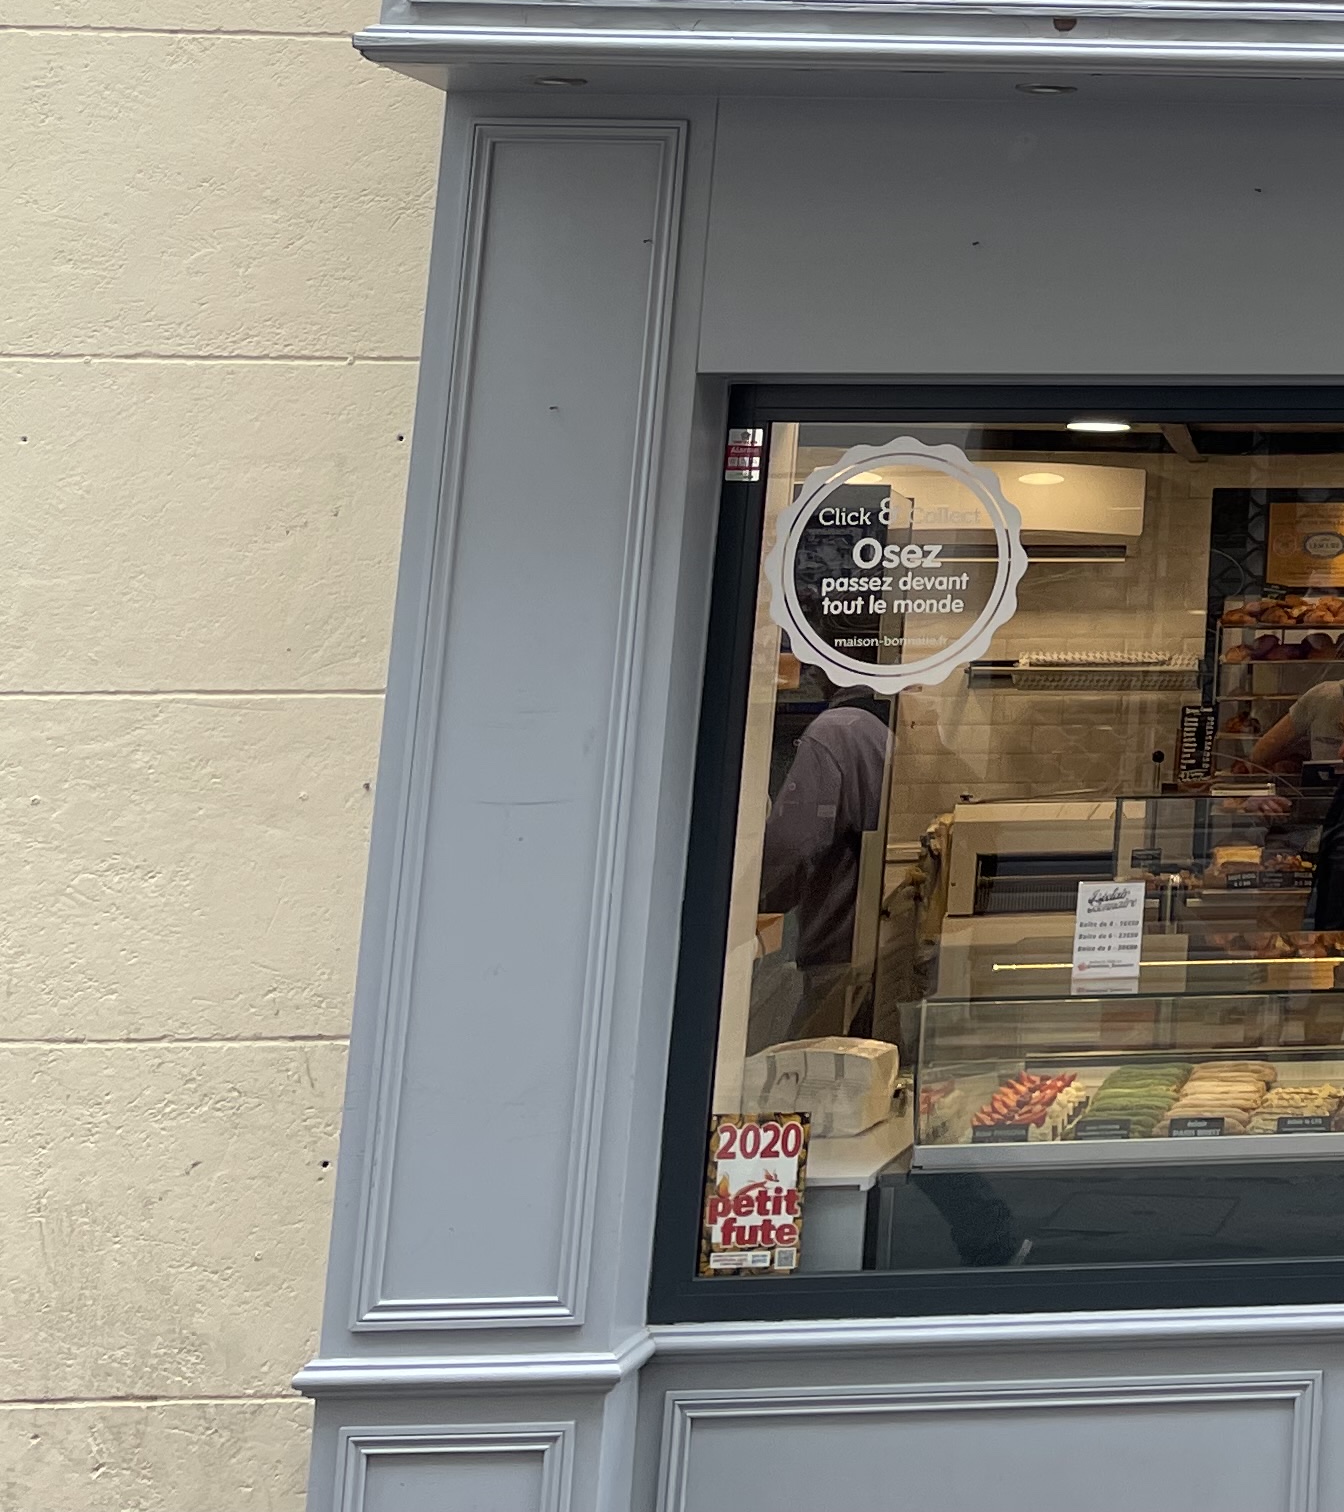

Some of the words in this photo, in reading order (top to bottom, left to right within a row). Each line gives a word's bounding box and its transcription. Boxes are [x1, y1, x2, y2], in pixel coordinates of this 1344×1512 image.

[819, 508, 871, 526] Click
[852, 538, 943, 569] Osez
[821, 576, 893, 596] passez
[899, 572, 969, 591] devant
[821, 596, 865, 615] tout
[868, 595, 887, 614] le
[893, 594, 964, 614] monde
[716, 1122, 803, 1160] 2020
[708, 1186, 800, 1226] petit
[721, 1217, 798, 1246] fute
